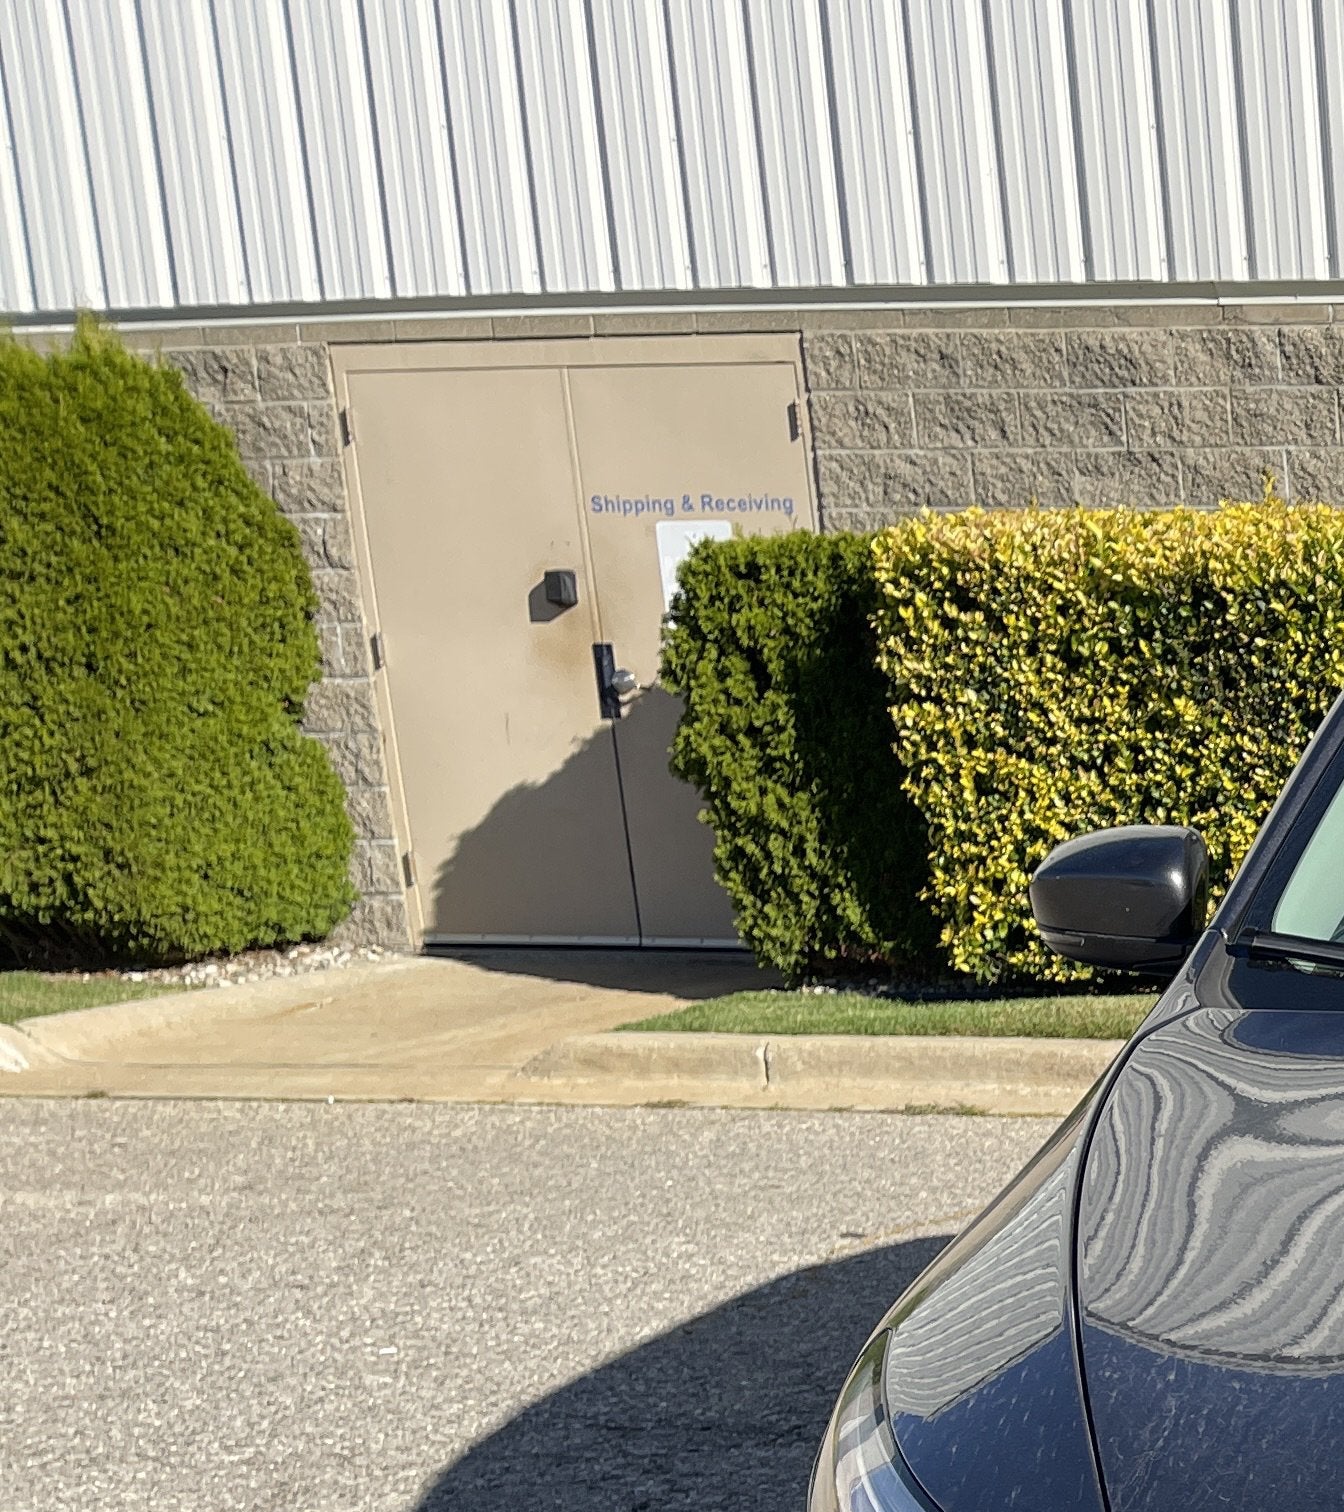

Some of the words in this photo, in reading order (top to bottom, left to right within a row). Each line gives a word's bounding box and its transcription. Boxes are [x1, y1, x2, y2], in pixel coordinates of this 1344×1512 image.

[591, 494, 675, 516] Shipping
[681, 494, 694, 513] &
[700, 493, 794, 516] Receiving
